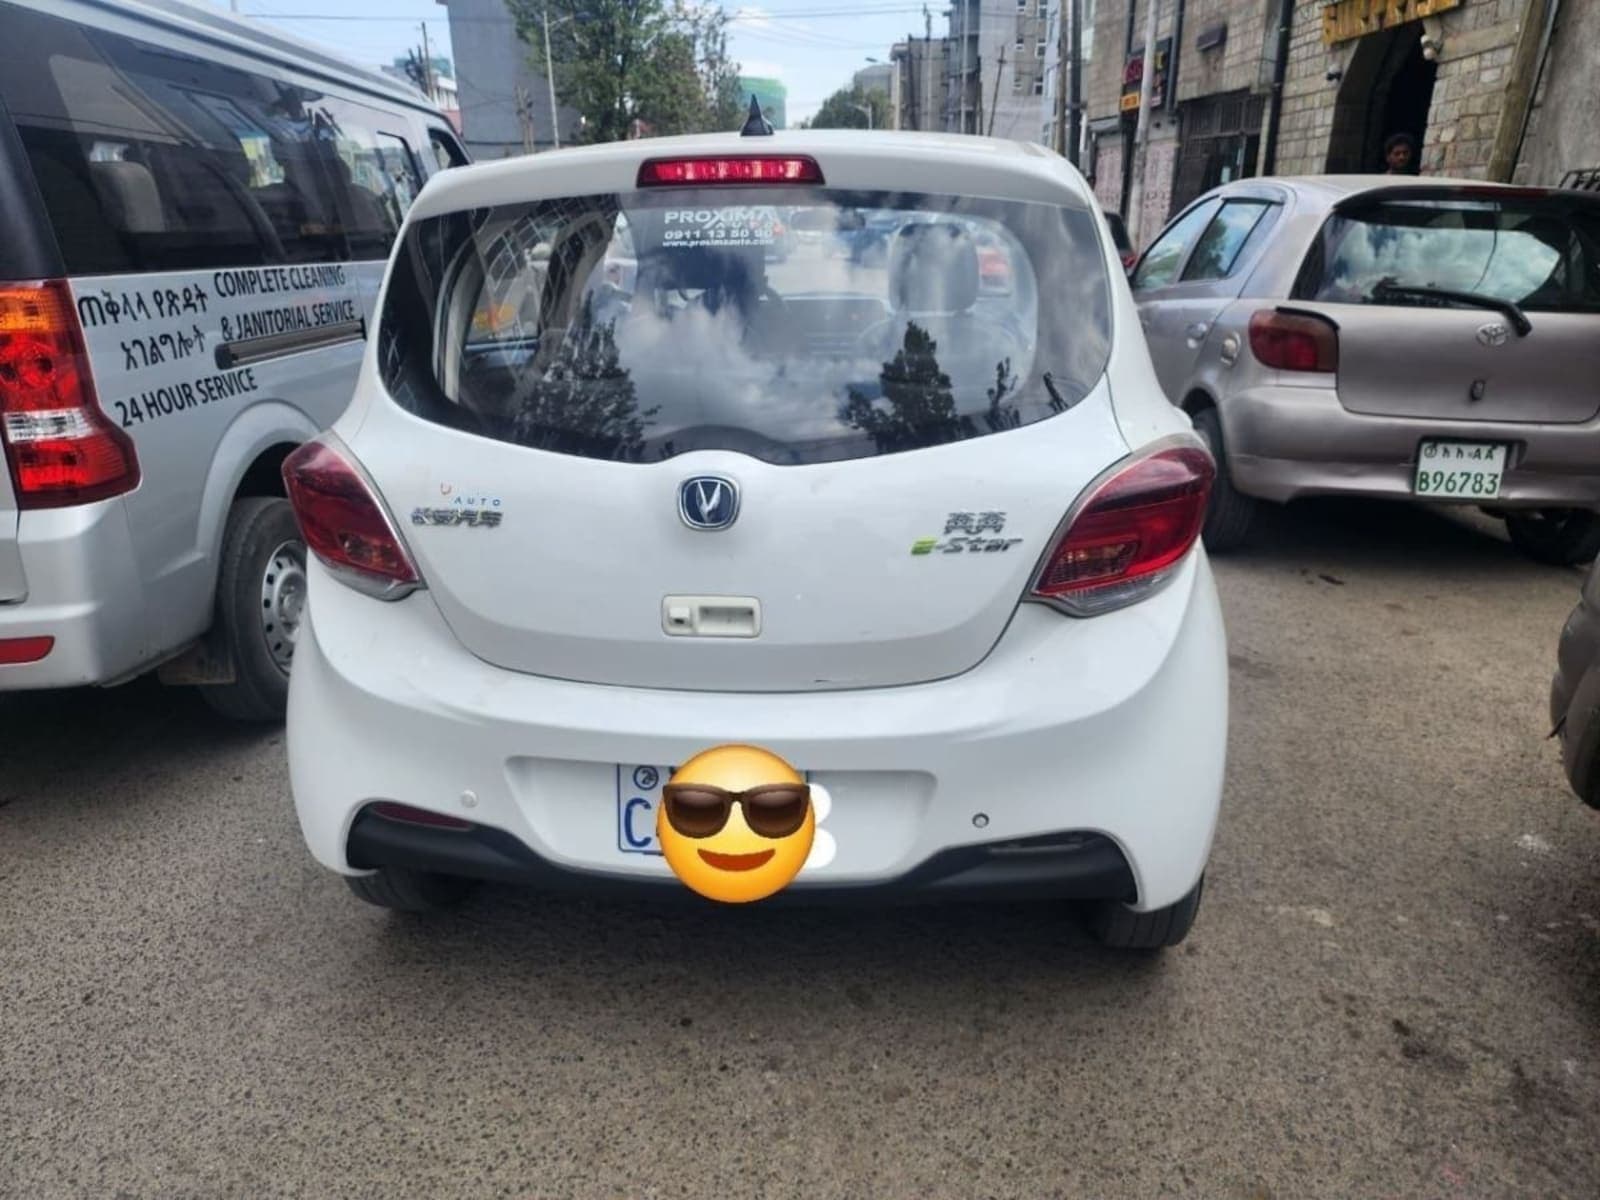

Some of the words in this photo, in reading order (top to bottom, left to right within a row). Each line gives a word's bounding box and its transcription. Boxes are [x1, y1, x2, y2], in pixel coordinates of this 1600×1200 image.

[664, 230, 701, 240] 0911
[707, 229, 726, 239] 13
[214, 268, 289, 297] COMPLETE
[290, 265, 346, 290] CLEANING
[220, 316, 234, 342] &
[236, 304, 312, 339] JANITORIAL
[312, 300, 355, 325] SERVICE
[114, 397, 144, 428] 24
[142, 382, 198, 419] HOUR
[195, 368, 258, 404] SERVICE
[1418, 470, 1499, 494] B96783
[454, 496, 501, 506] AUTO
